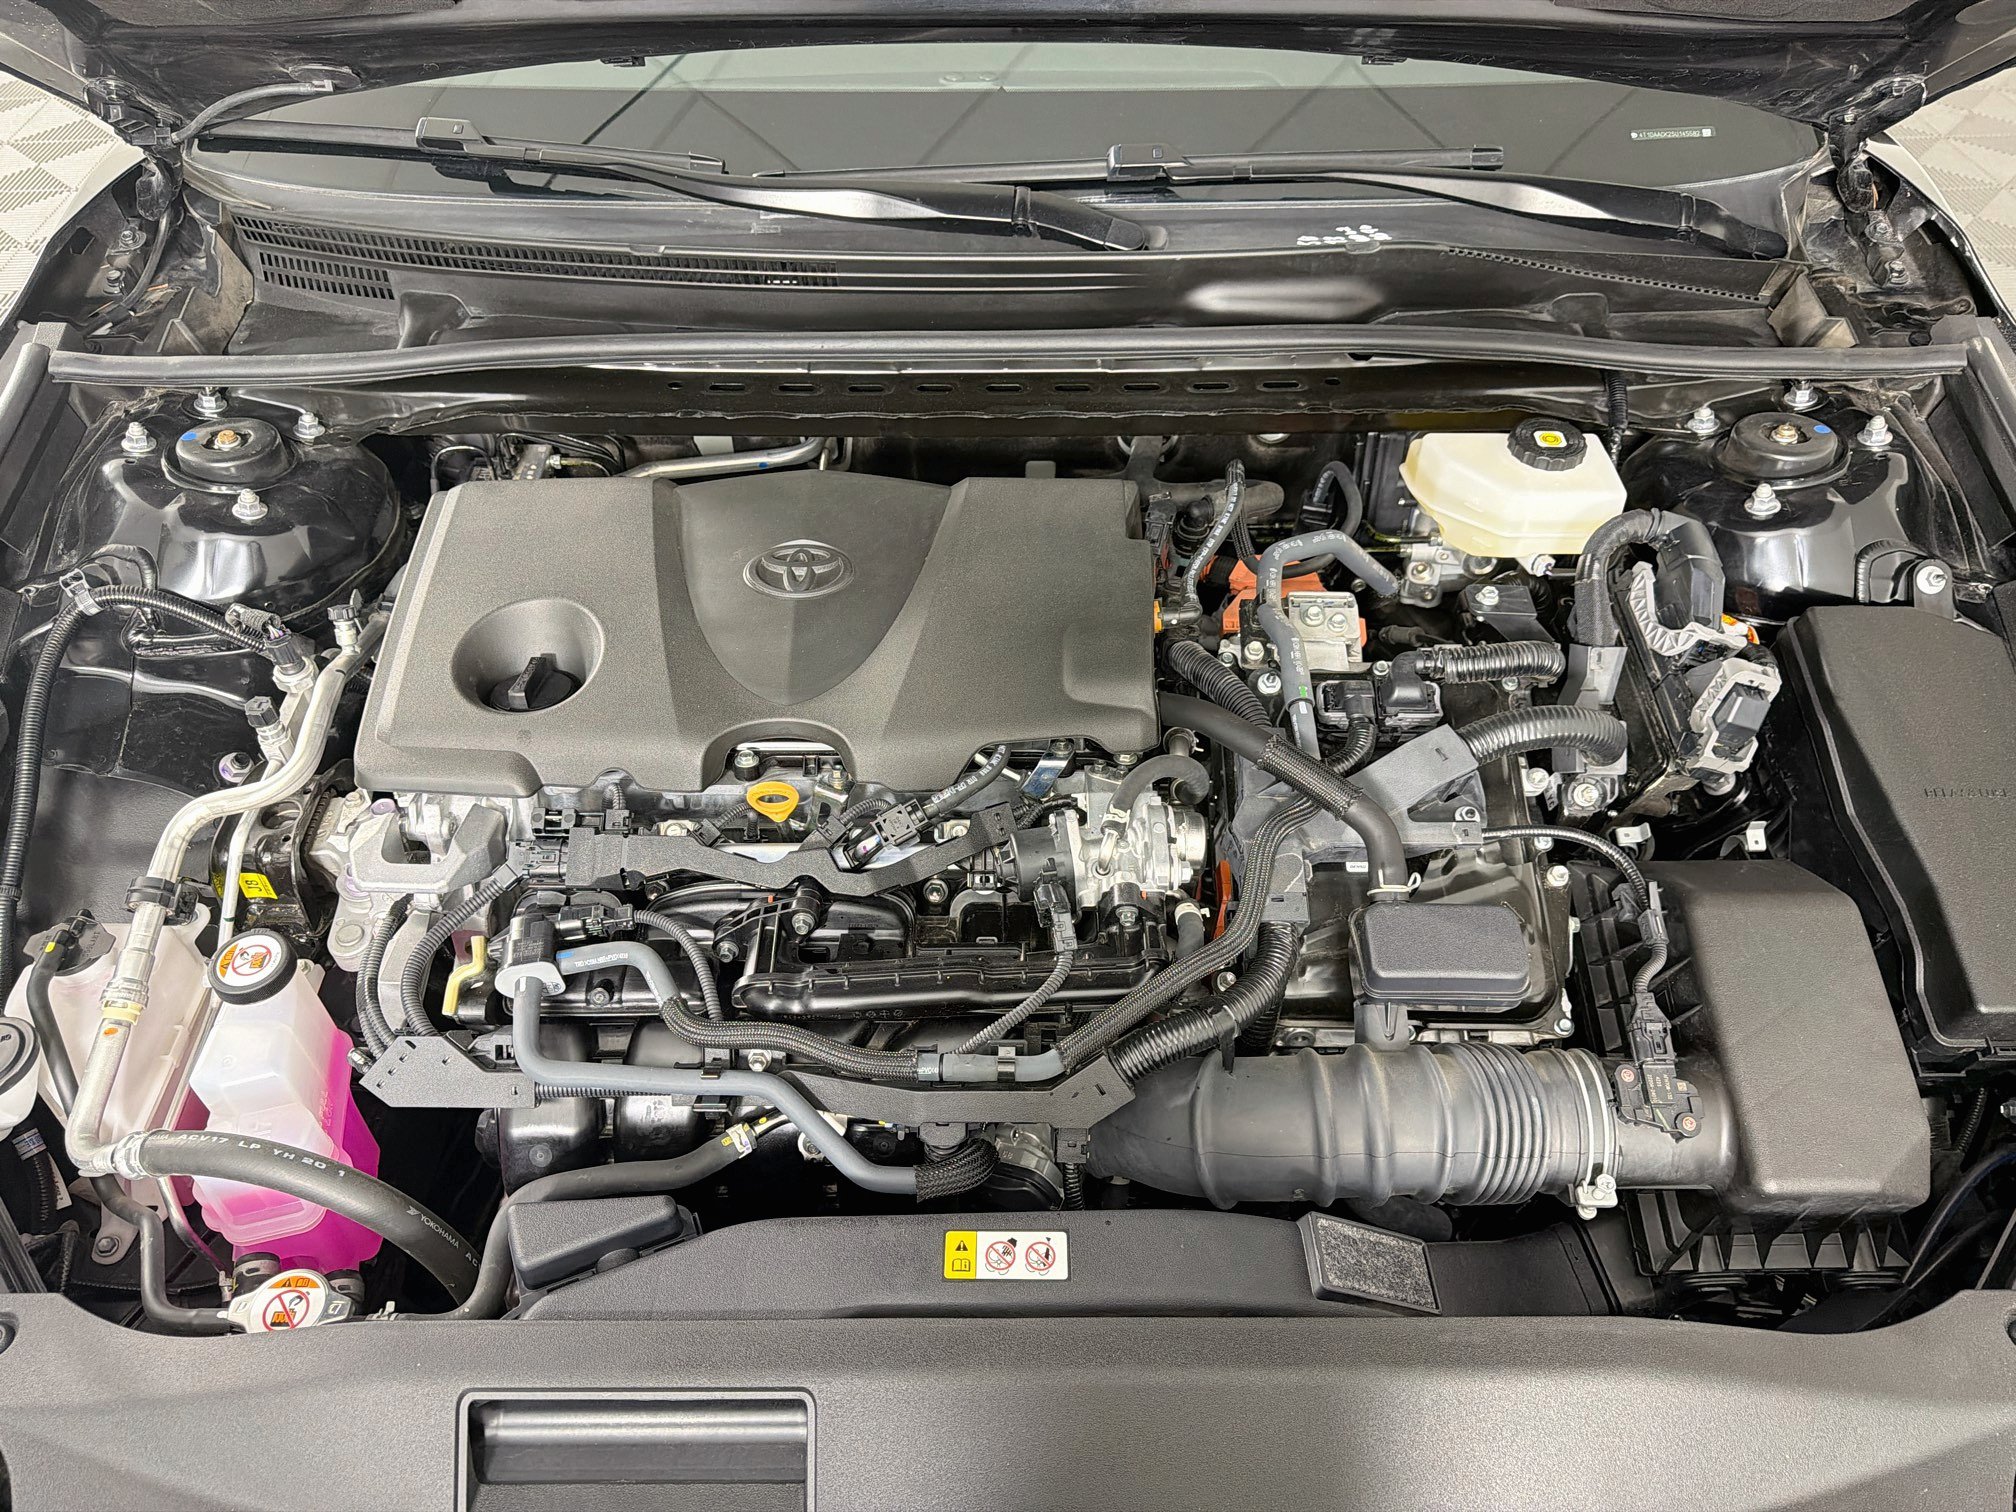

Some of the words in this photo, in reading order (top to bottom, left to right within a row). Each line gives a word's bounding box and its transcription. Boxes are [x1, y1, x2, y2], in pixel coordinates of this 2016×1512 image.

[244, 879, 263, 892] J8
[177, 1133, 229, 1144] ACV17
[237, 1140, 261, 1150] LP
[272, 1148, 296, 1160] YH
[301, 1156, 327, 1169] 20
[420, 1213, 460, 1249] YOKOHAMA
